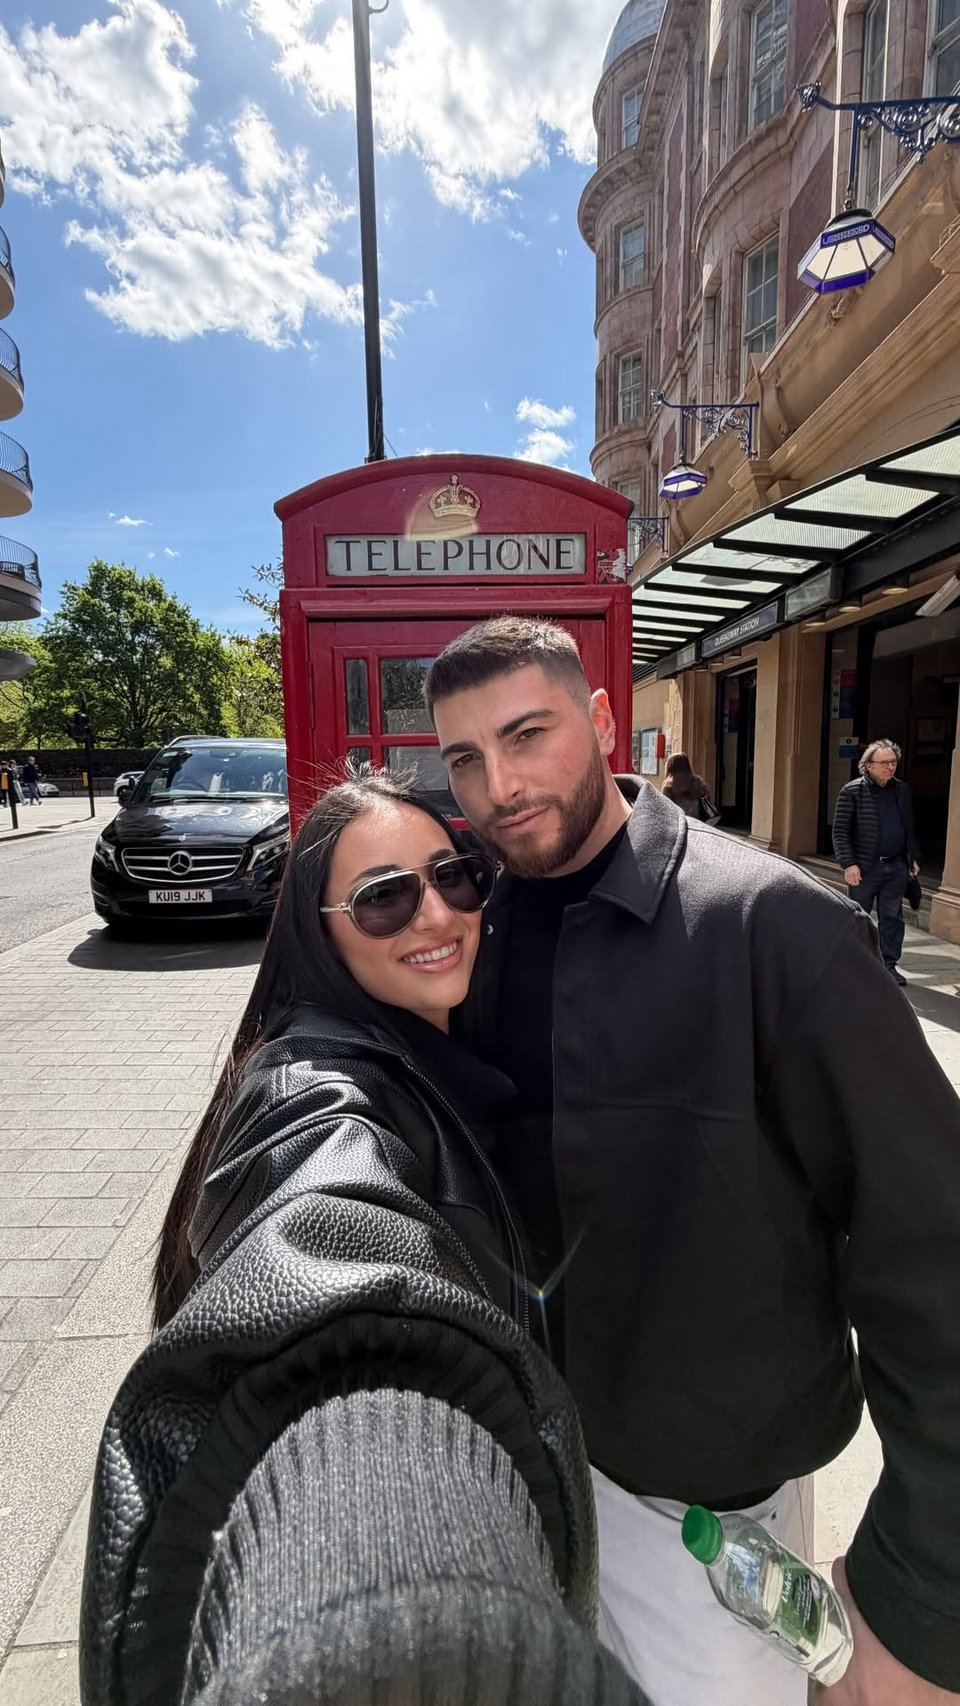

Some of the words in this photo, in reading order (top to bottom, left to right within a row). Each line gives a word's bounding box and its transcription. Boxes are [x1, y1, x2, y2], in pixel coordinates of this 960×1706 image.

[334, 538, 575, 572] TELEPHONE
[740, 616, 760, 634] STATION
[155, 891, 181, 902] KU19
[184, 891, 206, 902] JJK
